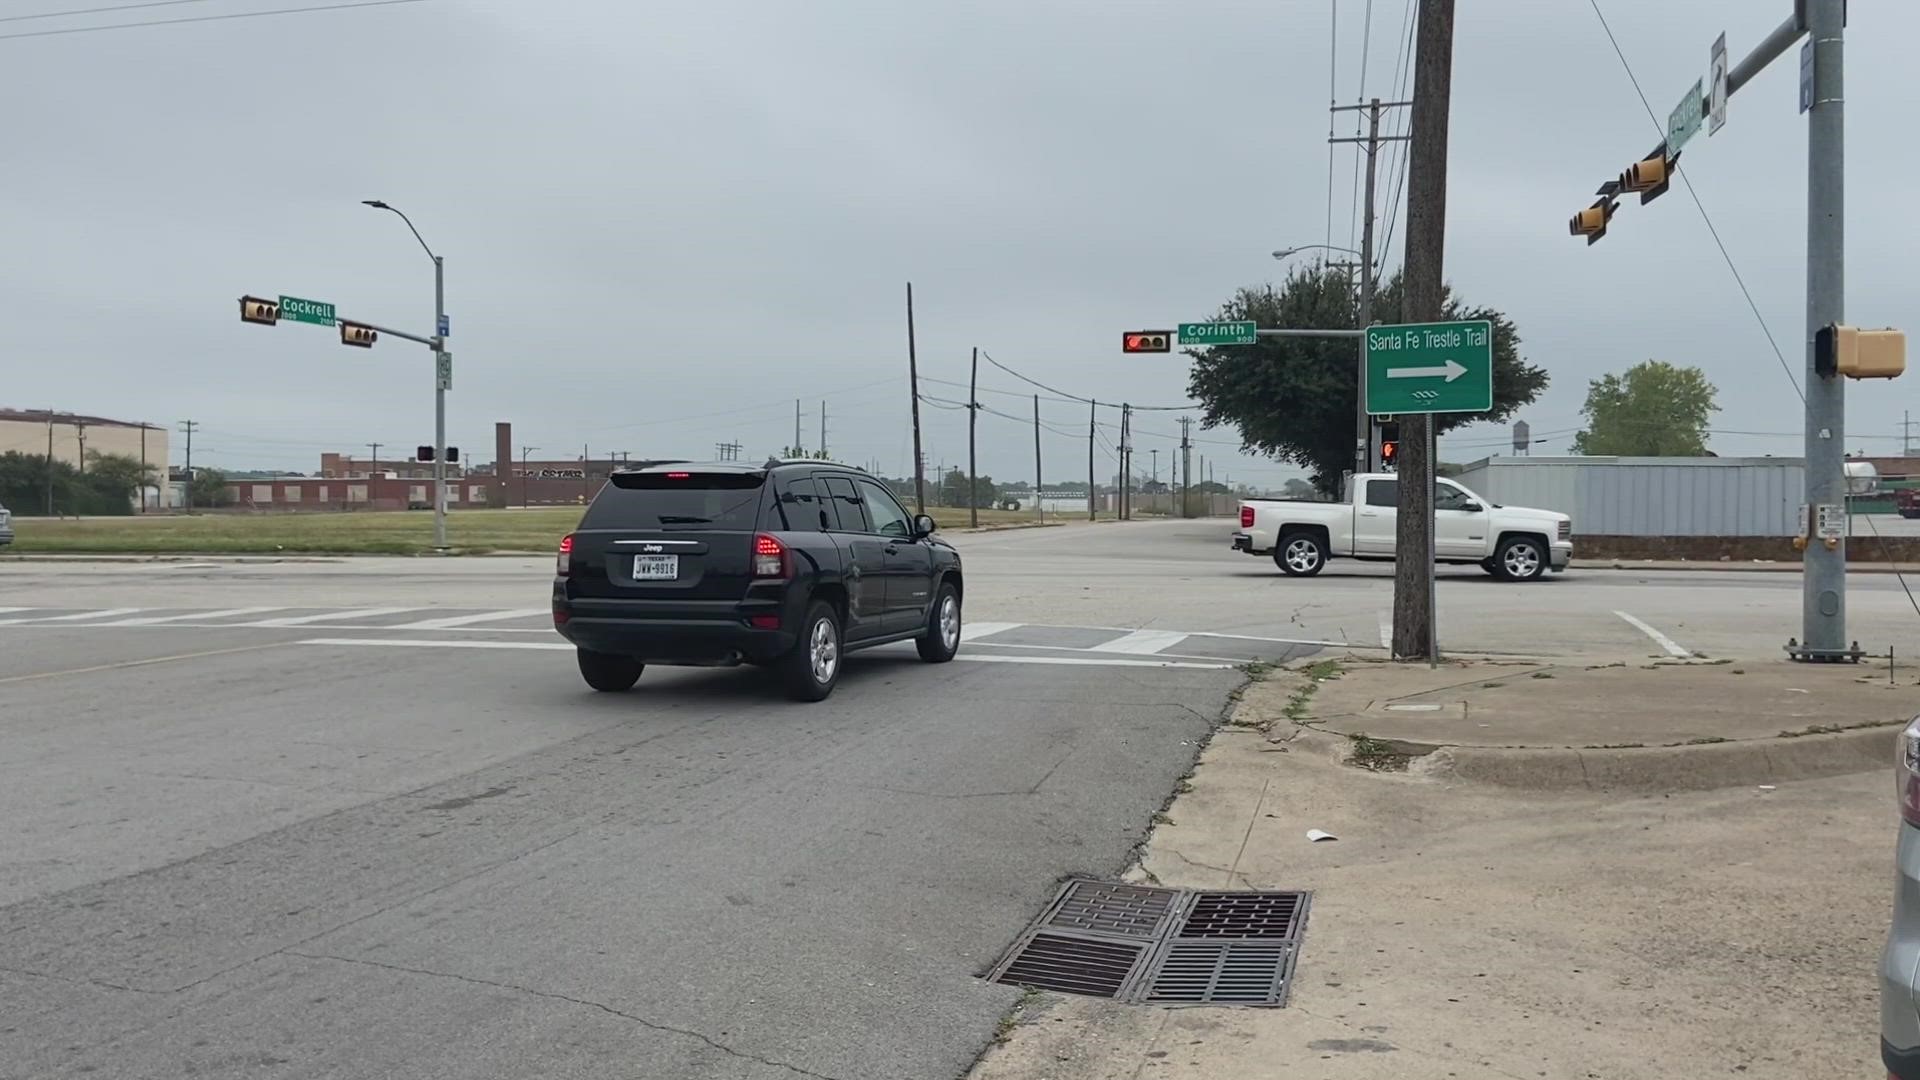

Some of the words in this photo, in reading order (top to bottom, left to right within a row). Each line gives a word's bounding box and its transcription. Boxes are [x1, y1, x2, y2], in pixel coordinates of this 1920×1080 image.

[283, 298, 331, 318] Cockrell
[1187, 323, 1245, 336] Corinth
[1369, 332, 1402, 351] Santa
[1405, 331, 1420, 349] Fe
[1423, 329, 1461, 349] Trestle
[1464, 328, 1487, 347] Trail
[643, 544, 663, 553] Jeep
